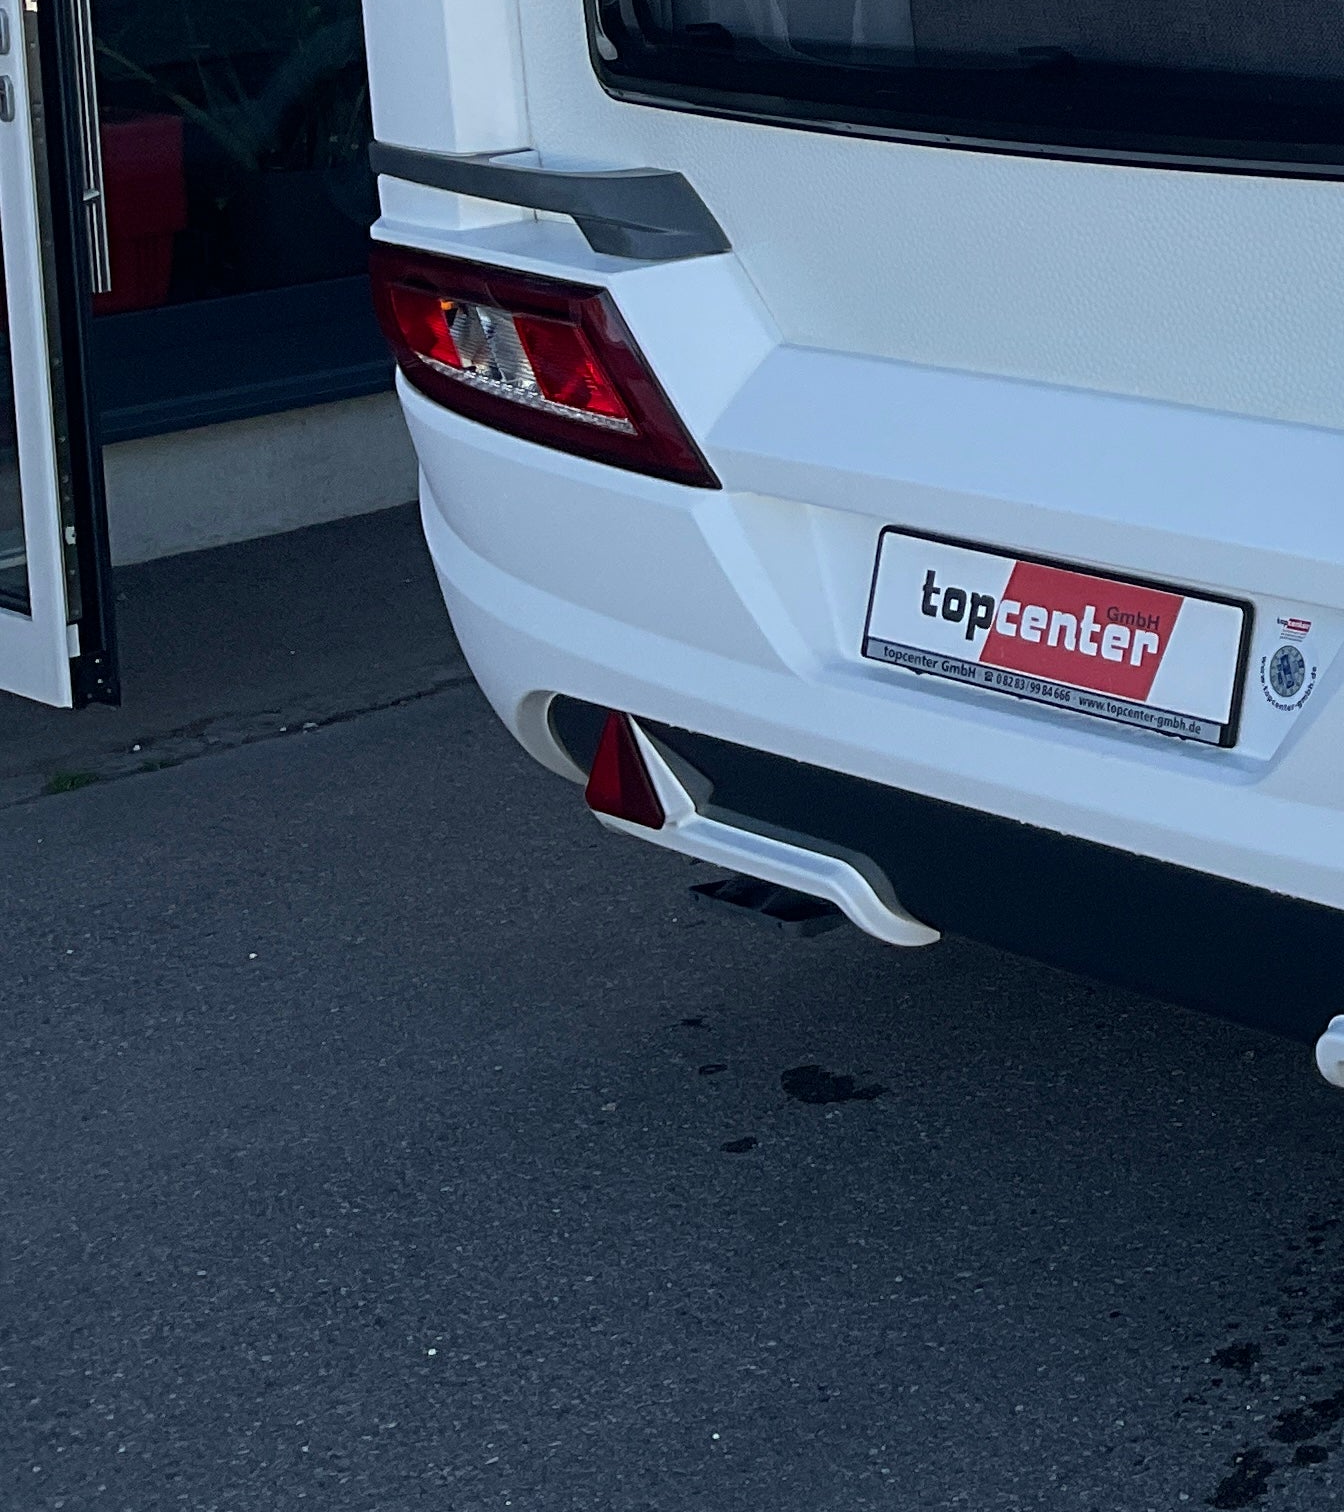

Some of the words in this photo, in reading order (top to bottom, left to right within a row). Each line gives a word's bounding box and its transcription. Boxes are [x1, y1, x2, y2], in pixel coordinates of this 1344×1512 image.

[921, 569, 1159, 666] topcenter
[1106, 606, 1160, 630] GmbH
[884, 645, 938, 670] topcenter
[941, 659, 977, 679] GmbH
[1078, 695, 1202, 736] www.topcenter-gmbh.de
